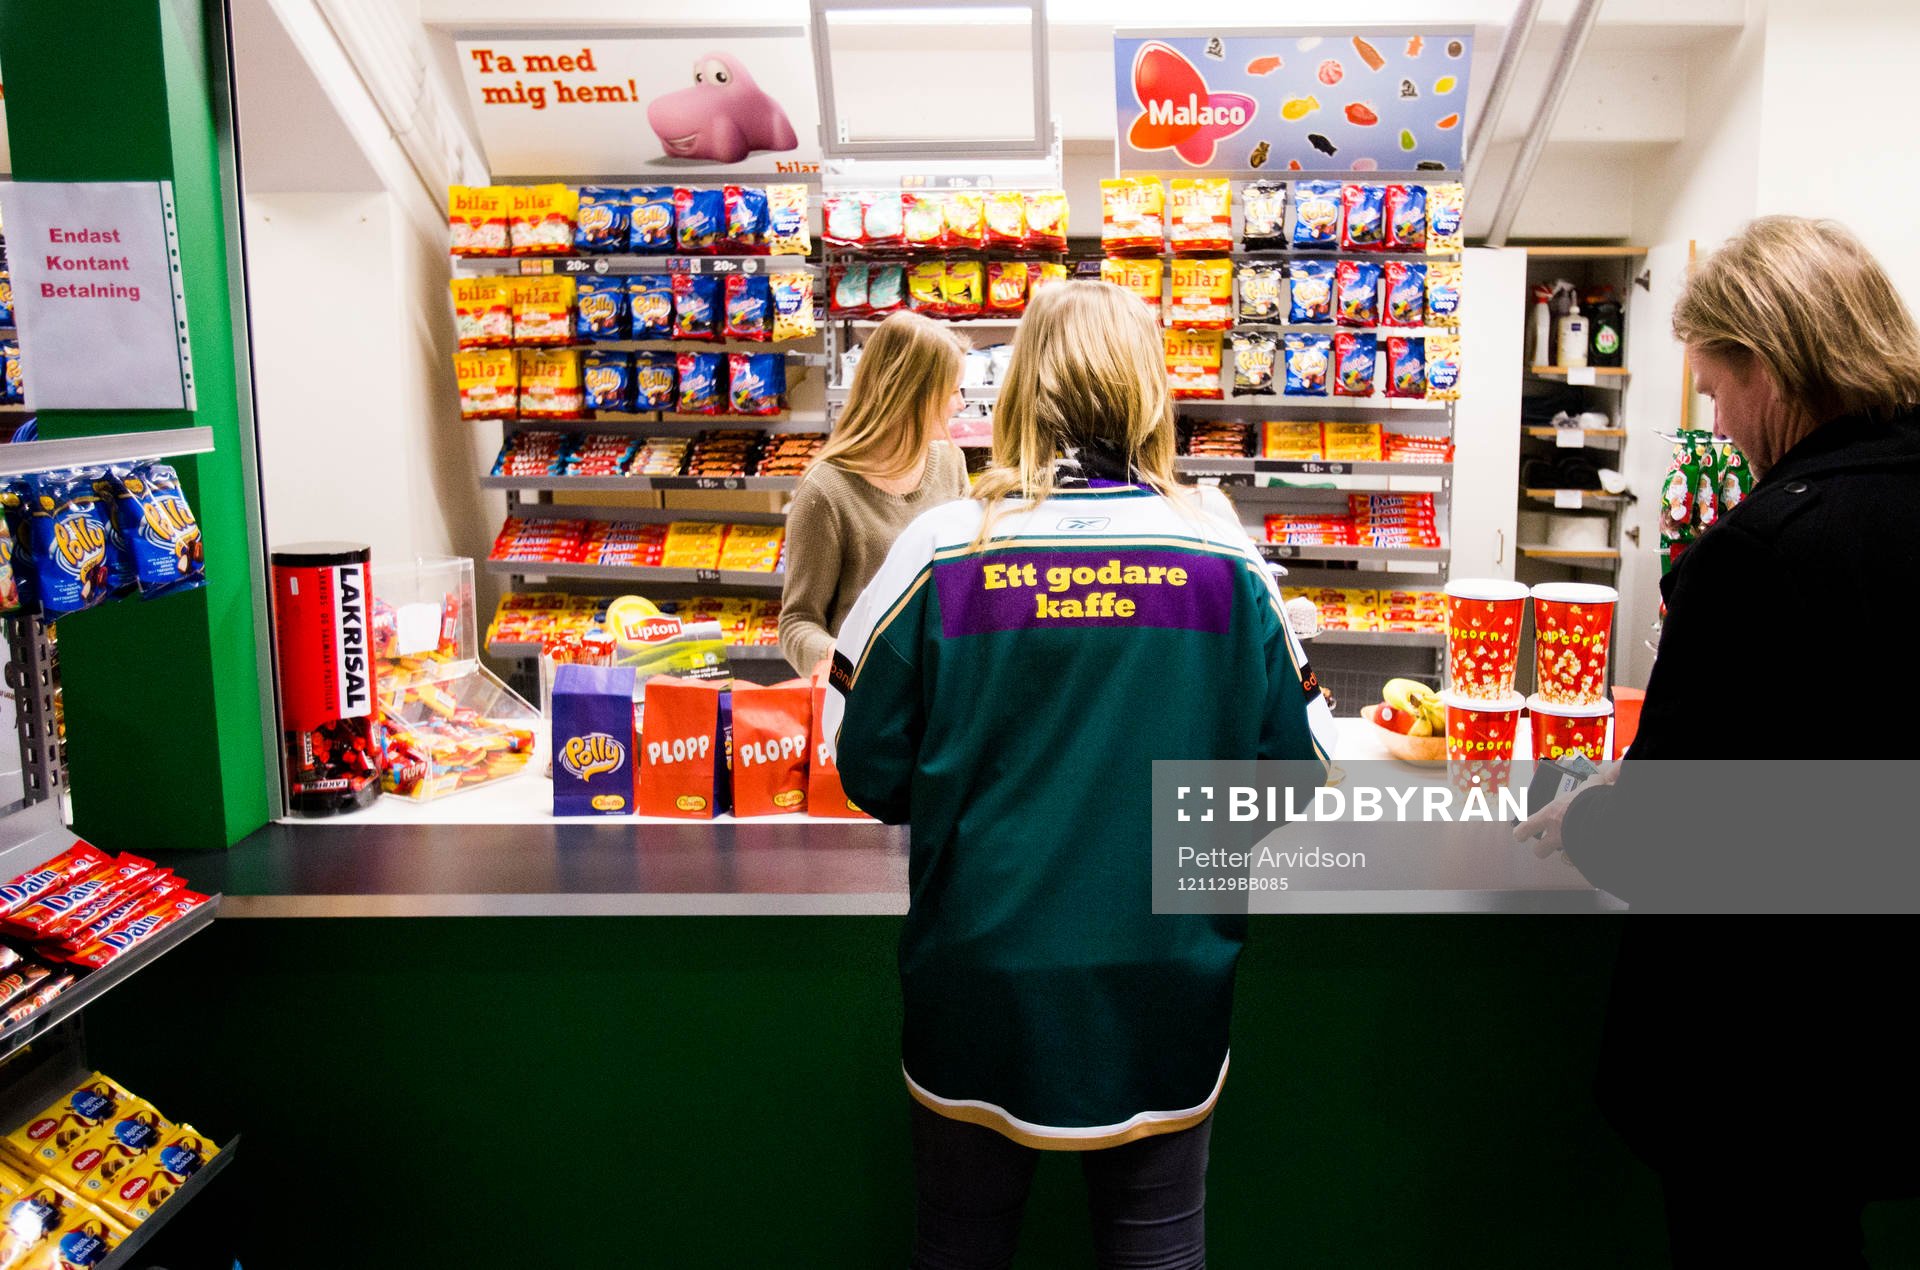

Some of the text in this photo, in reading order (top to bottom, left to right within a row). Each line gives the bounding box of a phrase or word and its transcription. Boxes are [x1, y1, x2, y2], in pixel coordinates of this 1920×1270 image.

[471, 48, 597, 73] Ta med
[482, 79, 639, 109] mig hem!
[1148, 93, 1246, 126] Malaco
[775, 160, 820, 174] bilar
[456, 195, 499, 211] bilar
[1173, 190, 1222, 206] bilr
[578, 207, 612, 227] Polly
[631, 206, 669, 228] Polly
[48, 227, 121, 244] Endast
[46, 255, 130, 271] Kontant
[1103, 270, 1153, 287] bilar
[1173, 270, 1222, 287] bilar
[40, 282, 141, 302] Betalning
[458, 285, 497, 301] bilar
[513, 287, 560, 305] bilar
[578, 296, 614, 317] Polly
[632, 295, 670, 316] Polly
[1166, 338, 1215, 356] bilar
[457, 361, 506, 379] bilar
[521, 359, 567, 377] bilar
[637, 367, 672, 390] Polly
[584, 368, 620, 390] Polly
[1370, 495, 1404, 507] Daim
[143, 498, 200, 546] Polly
[54, 516, 106, 572] Polly
[982, 559, 1189, 593] Ett godare
[1035, 592, 1136, 619] kaffe
[339, 567, 366, 708] LAKRISAL
[627, 622, 679, 641] Lipton
[1449, 626, 1499, 641] pcorn
[565, 736, 620, 782] Polly
[648, 734, 711, 766] PLOPP
[740, 734, 807, 768] PLOPP
[402, 762, 426, 780] PLOPP
[0, 869, 59, 903] Daim
[39, 880, 106, 912] Daim
[101, 914, 163, 950] Daim
